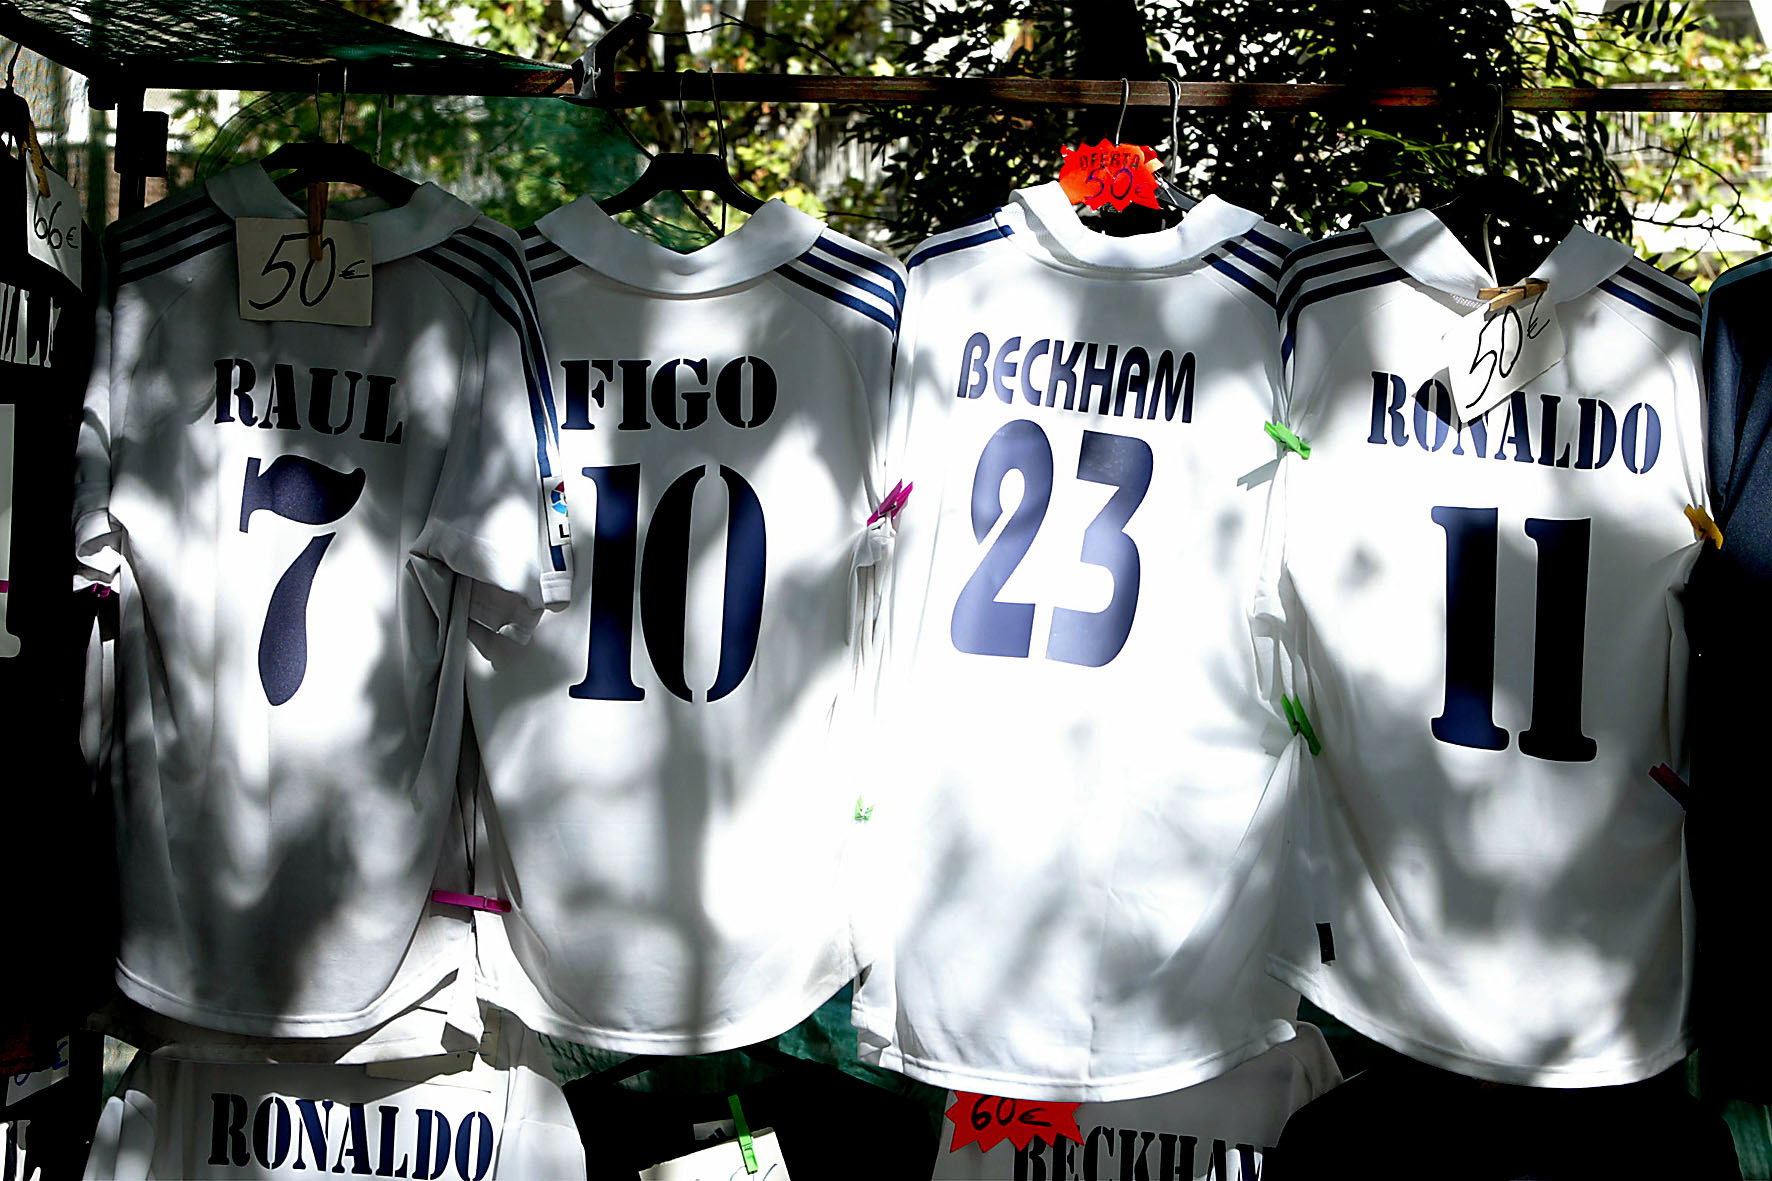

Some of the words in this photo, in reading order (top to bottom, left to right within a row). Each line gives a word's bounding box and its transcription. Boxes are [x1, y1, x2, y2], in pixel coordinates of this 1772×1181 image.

[213, 358, 404, 446] RAUL
[560, 354, 778, 431] FIGO
[957, 331, 1196, 424] BECKHAM
[239, 454, 367, 707] 7
[568, 462, 768, 703] 10
[950, 418, 1154, 668] 23
[1430, 505, 1598, 762] 11
[207, 1093, 494, 1181] RONALDO
